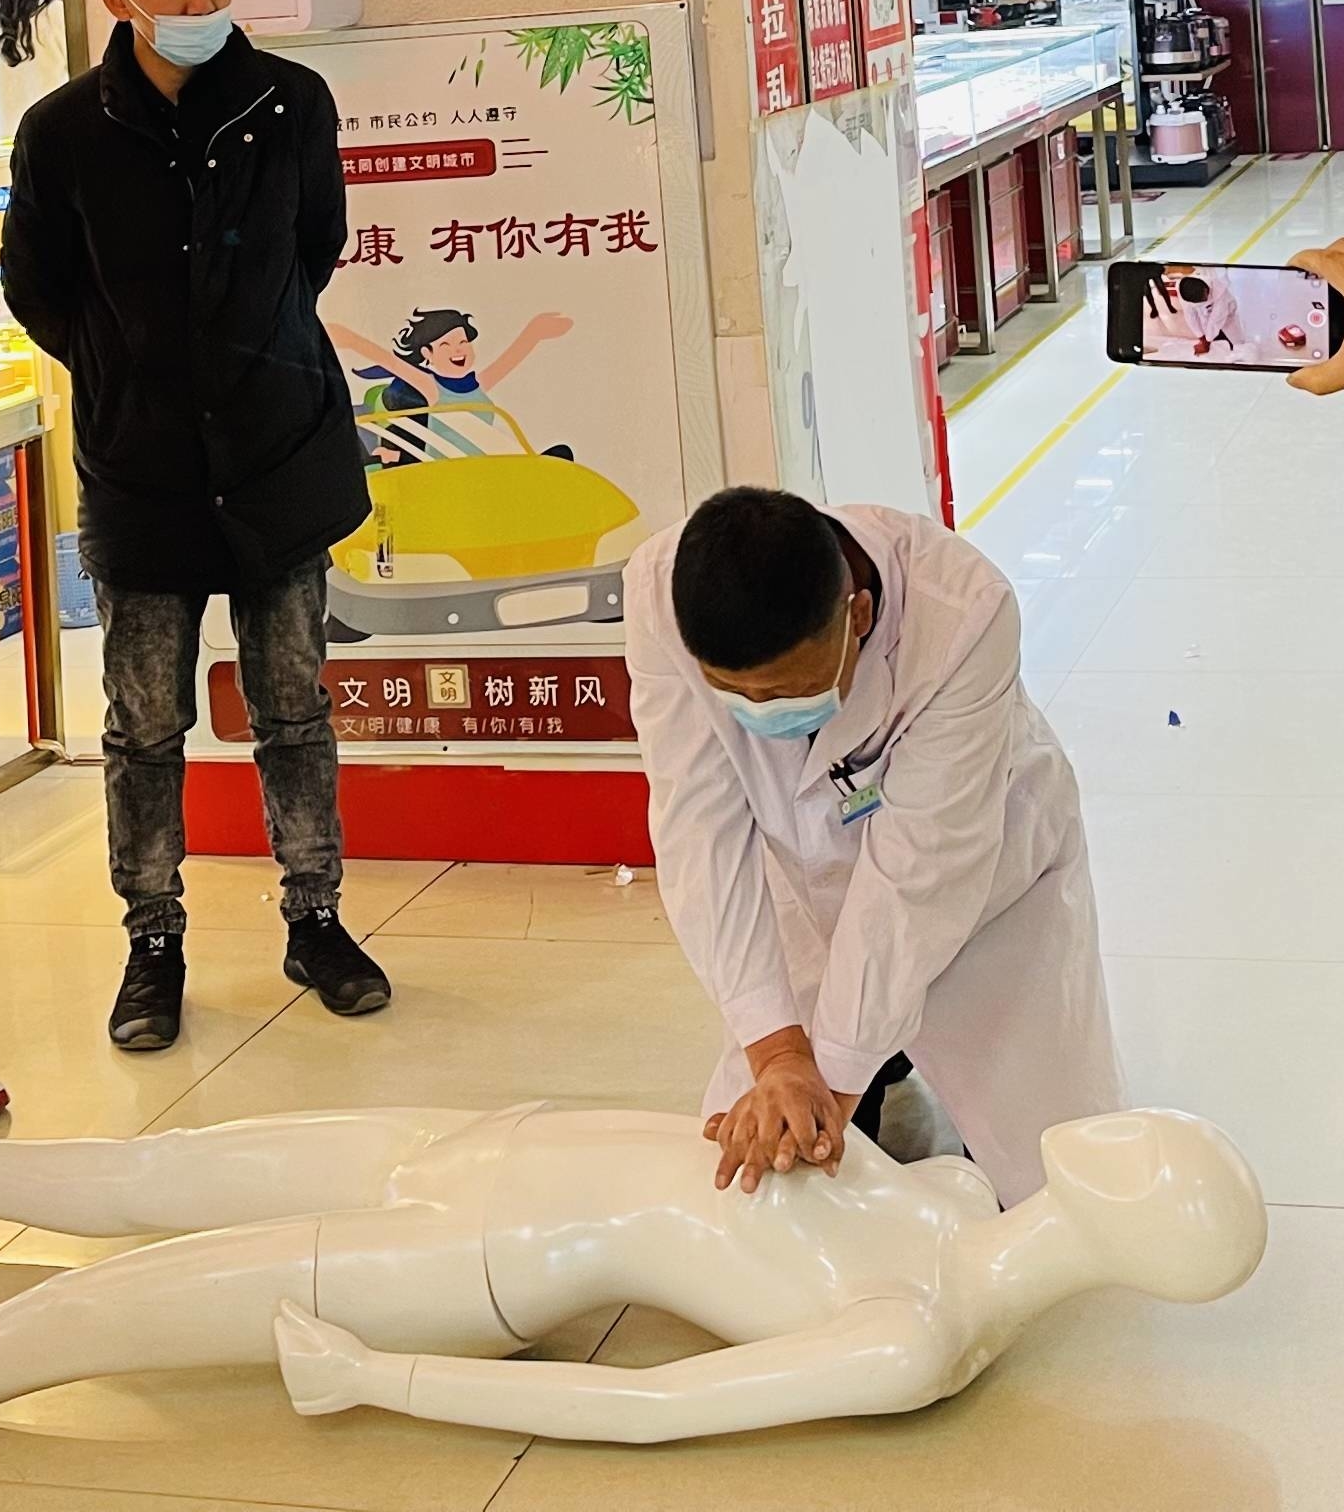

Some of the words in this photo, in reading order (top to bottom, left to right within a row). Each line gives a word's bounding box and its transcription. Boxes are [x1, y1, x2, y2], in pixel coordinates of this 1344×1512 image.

[369, 112, 437, 129] 市民公约
[451, 106, 517, 124] 人人遵守
[342, 152, 476, 175] 共同创建文明城市
[430, 209, 659, 263] 有你有我
[338, 677, 411, 708] 文明
[439, 671, 457, 701] 文明
[485, 676, 606, 708] 树新风
[316, 908, 332, 920] M
[149, 936, 165, 948] M
